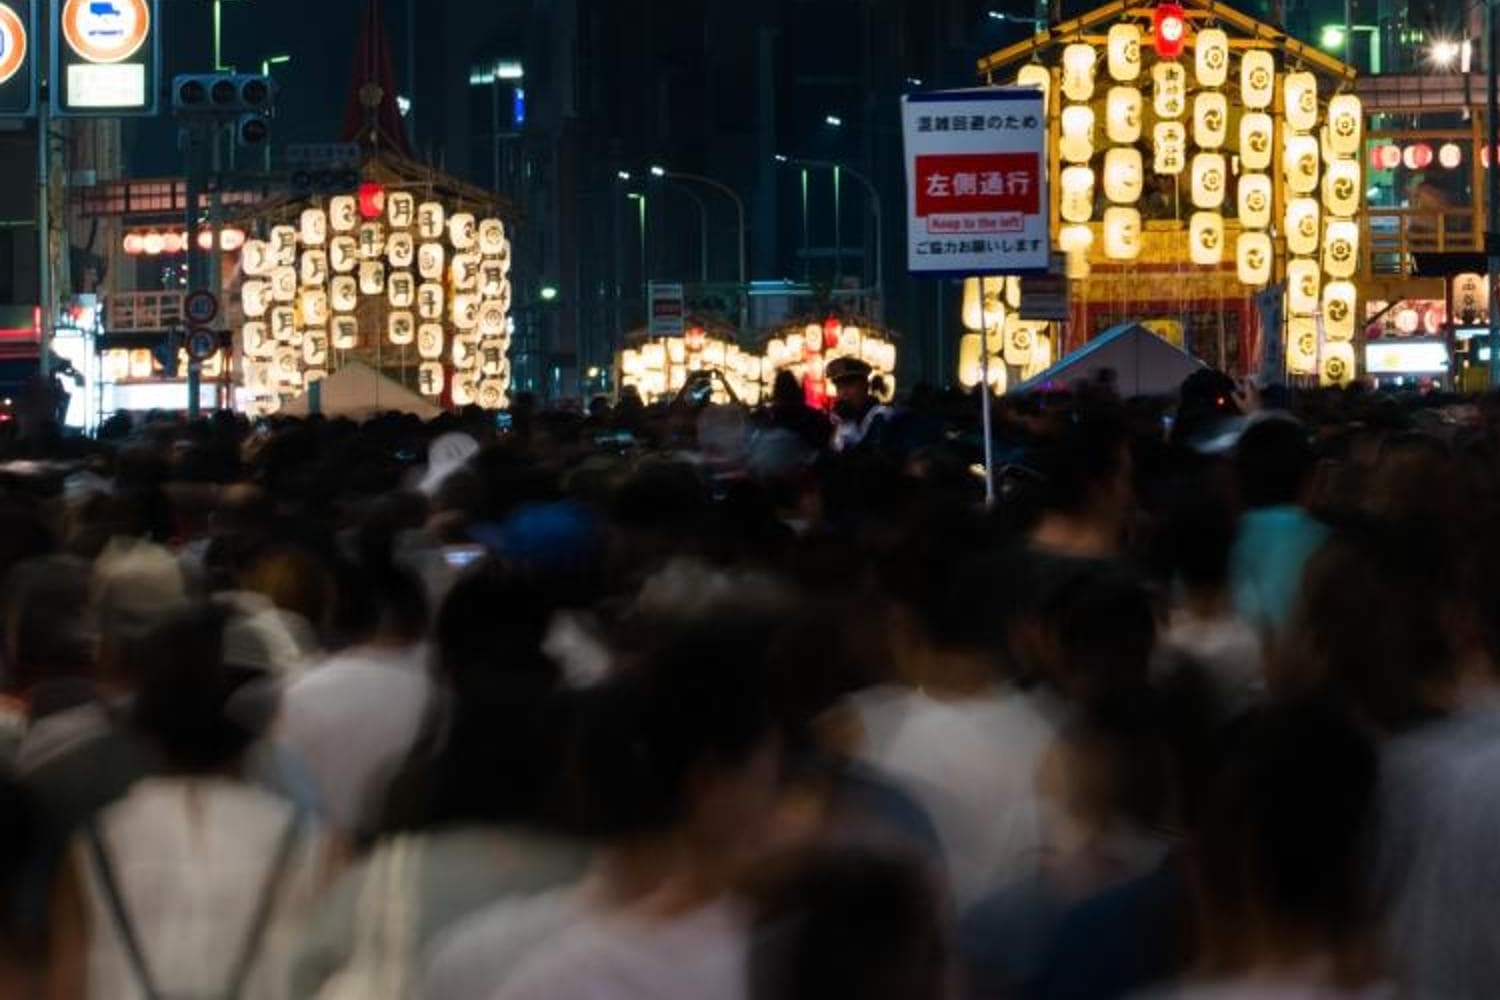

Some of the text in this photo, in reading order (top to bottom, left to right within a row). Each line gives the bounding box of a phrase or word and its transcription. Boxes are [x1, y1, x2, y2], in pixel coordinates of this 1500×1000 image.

[926, 170, 1031, 197] 左側通行
[916, 239, 1041, 255] ご協力お願いします
